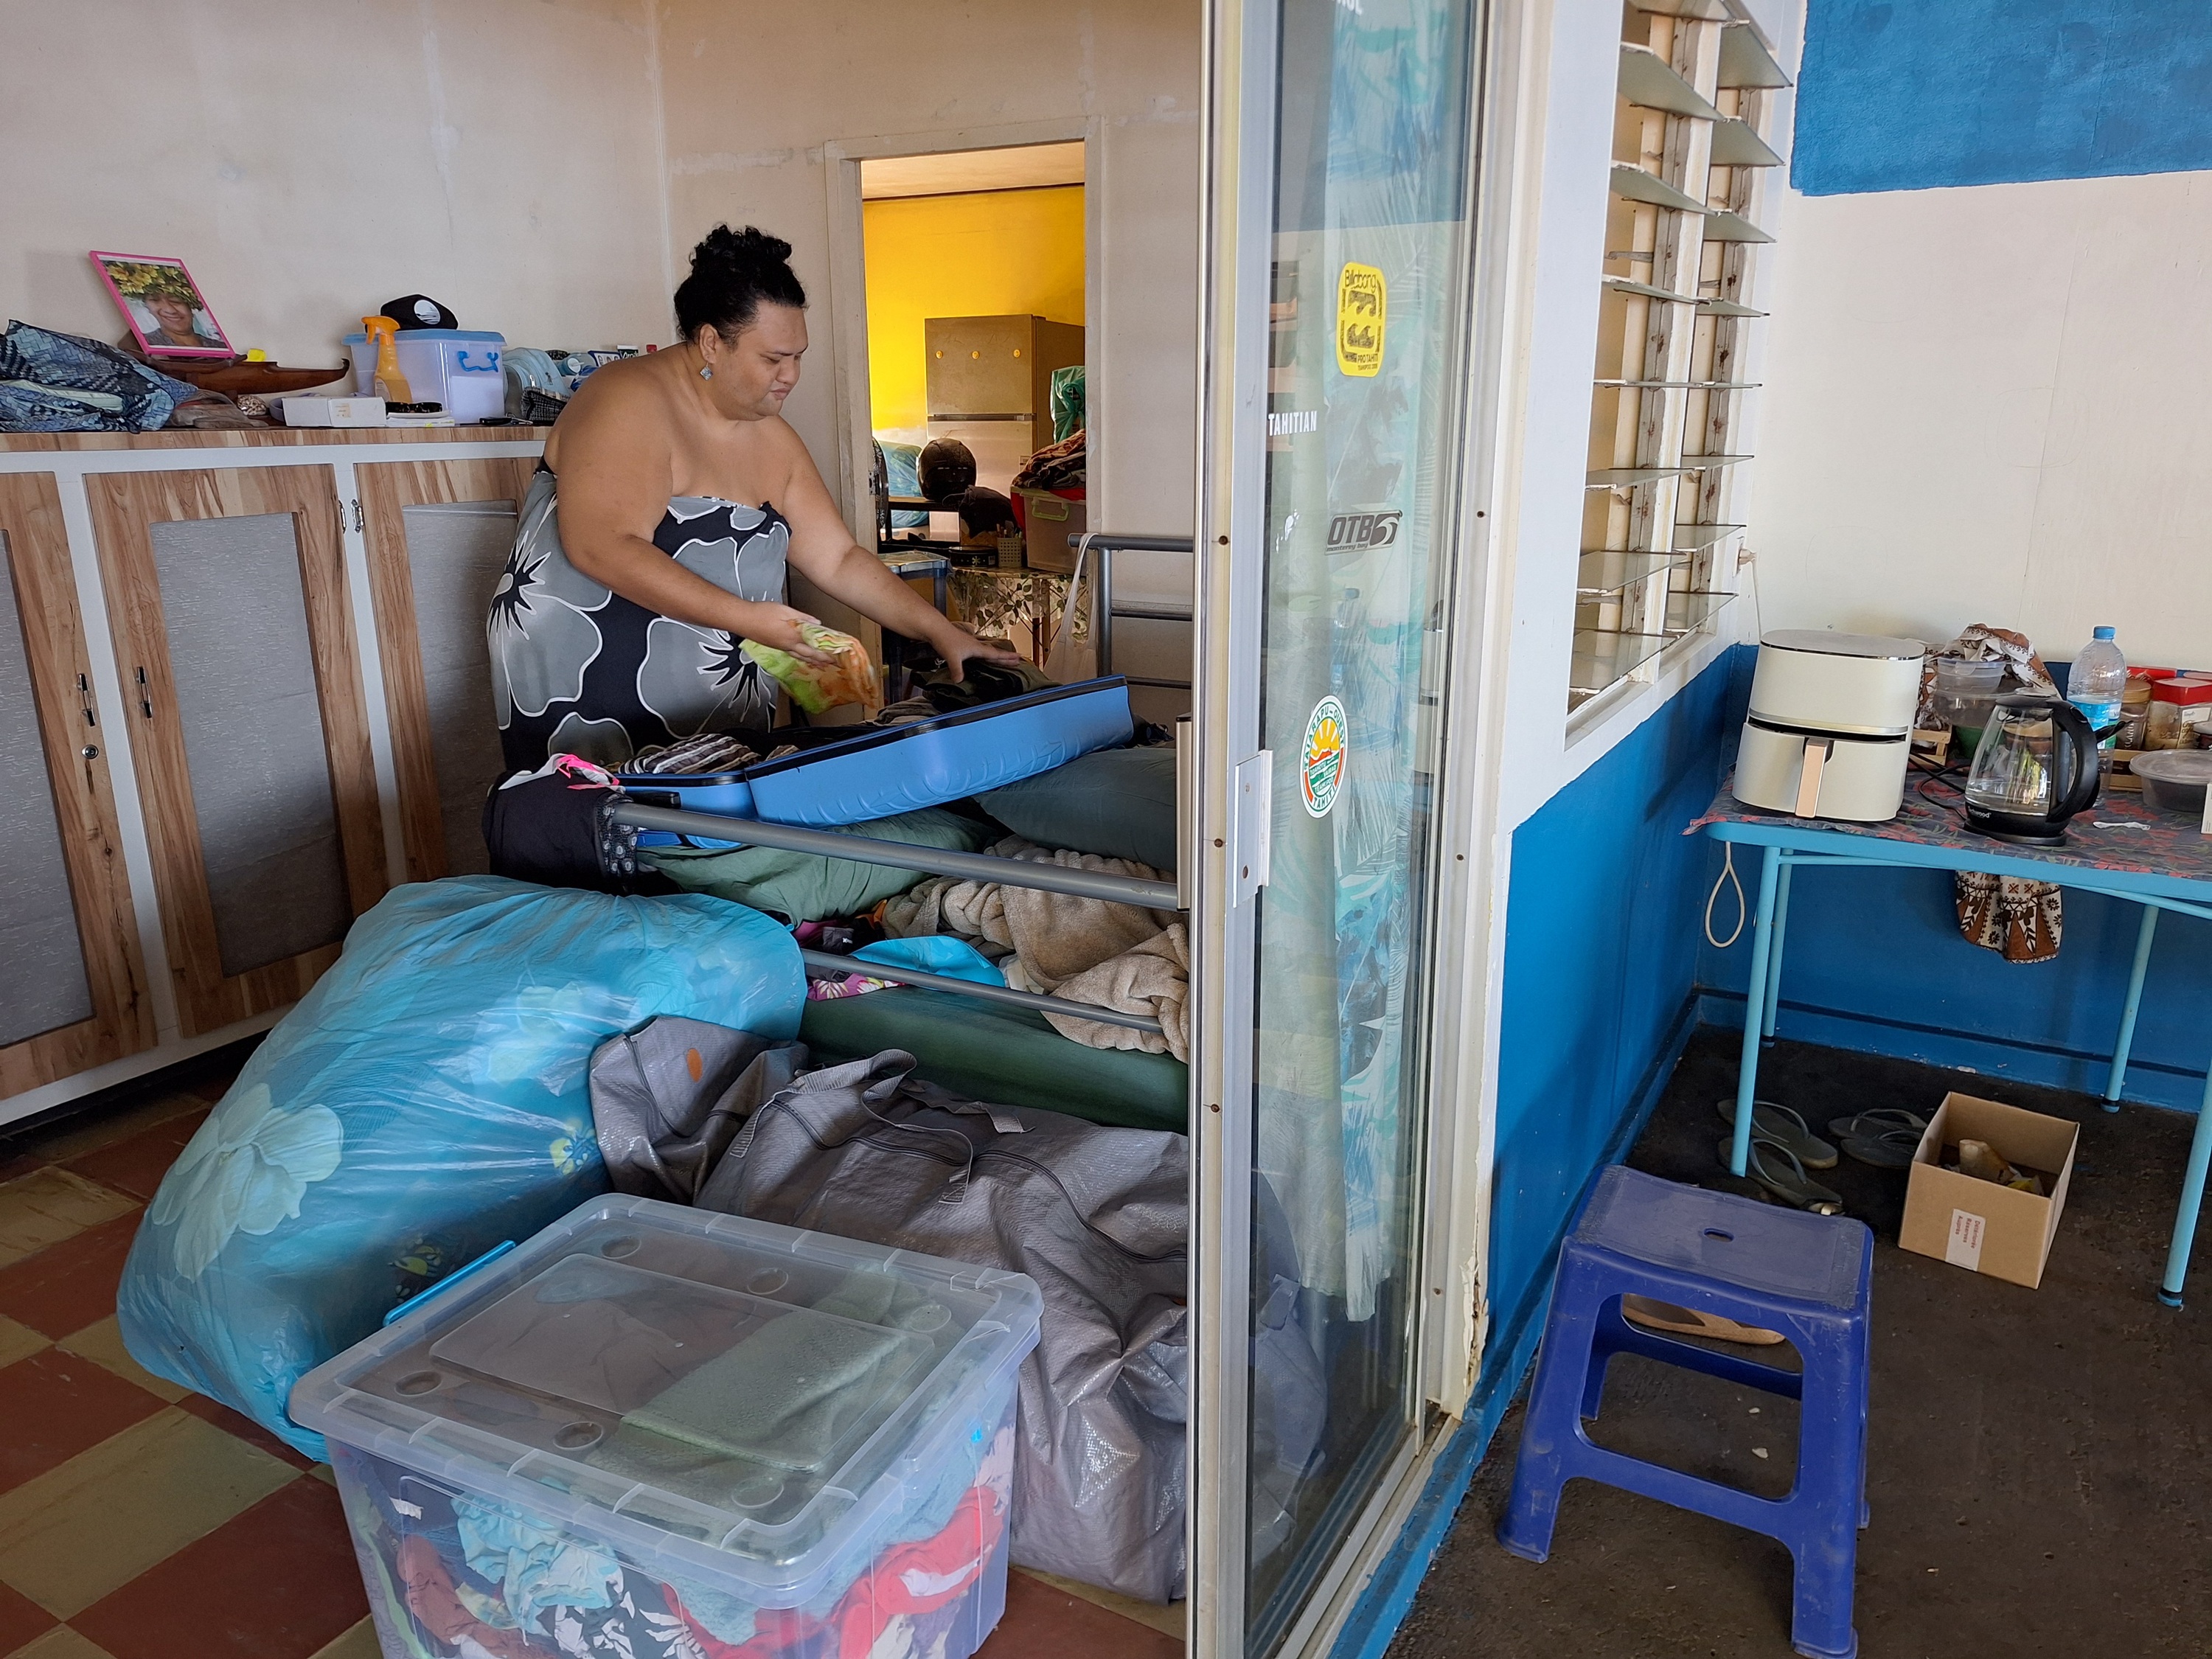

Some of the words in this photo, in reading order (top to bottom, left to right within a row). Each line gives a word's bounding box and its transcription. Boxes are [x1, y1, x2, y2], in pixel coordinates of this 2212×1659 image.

[1268, 410, 1317, 437] TAHITIAN
[1327, 515, 1375, 546] OTB
[1313, 785, 1335, 809] TAHITI
